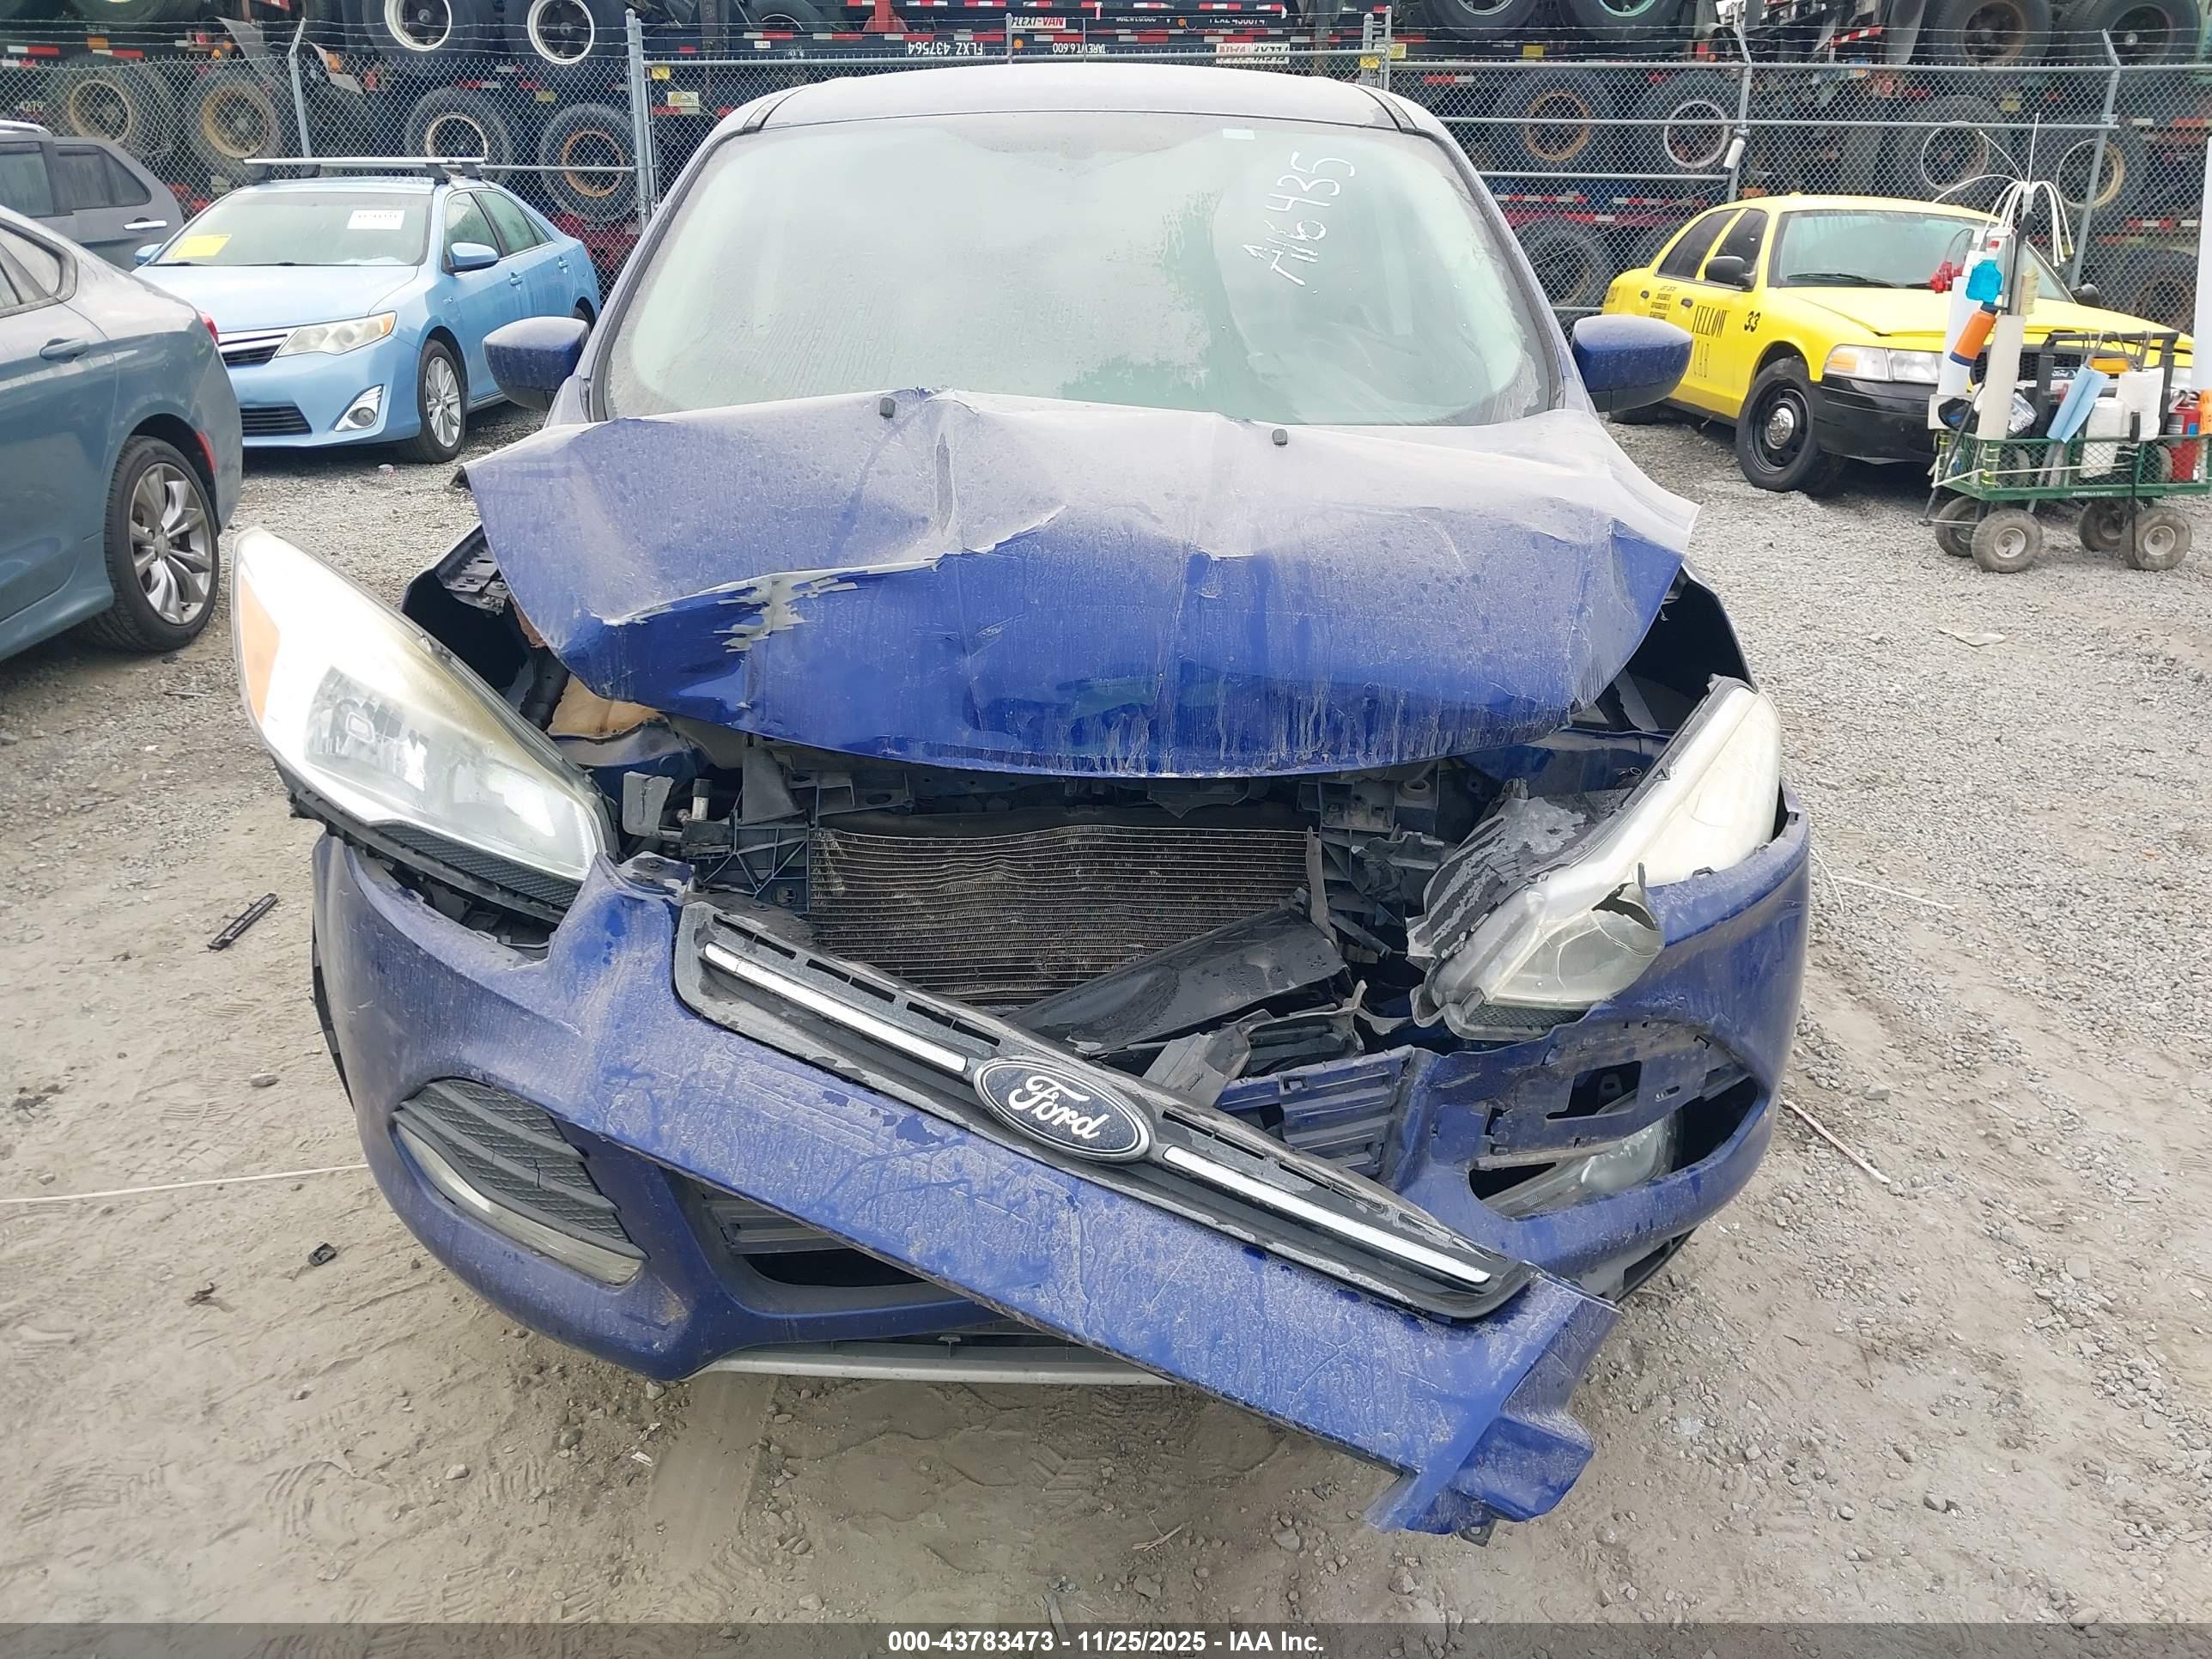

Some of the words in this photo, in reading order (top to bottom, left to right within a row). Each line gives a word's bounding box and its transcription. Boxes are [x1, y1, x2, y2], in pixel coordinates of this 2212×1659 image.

[908, 41, 951, 55] 437564
[956, 42, 983, 56] FLXZ
[1744, 310, 1761, 333] 33
[1008, 1075, 1110, 1139] Ford
